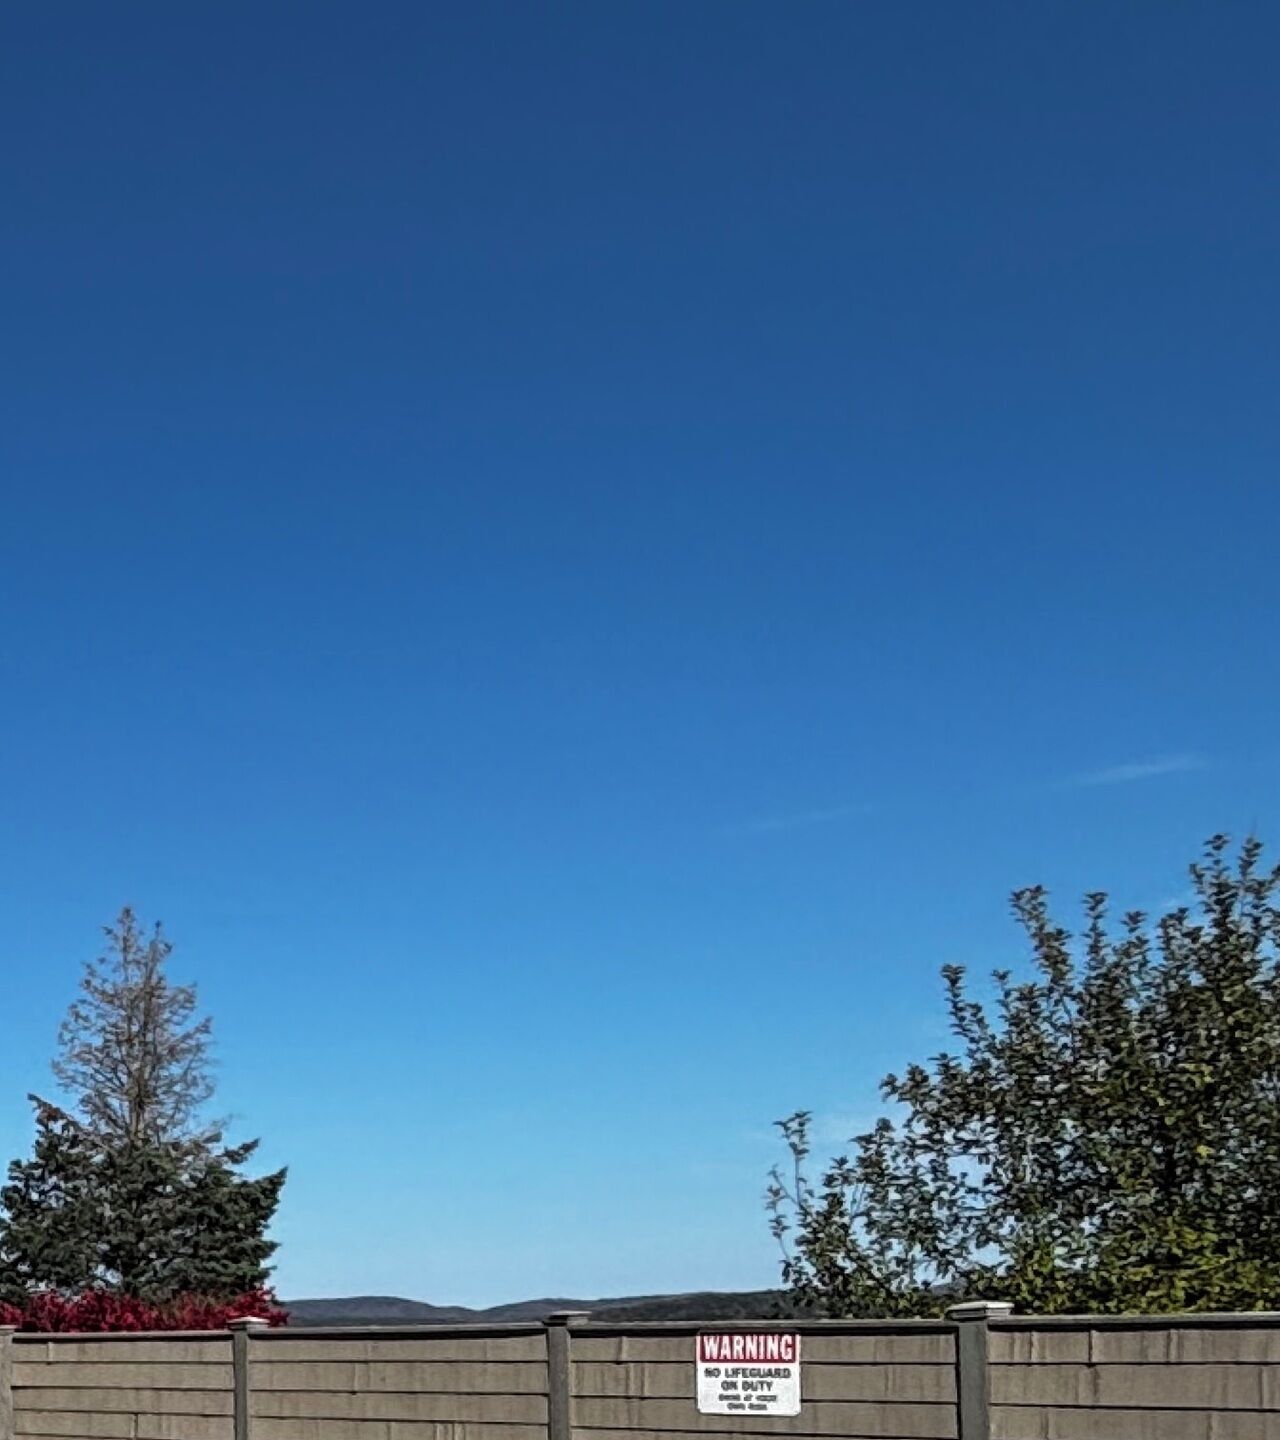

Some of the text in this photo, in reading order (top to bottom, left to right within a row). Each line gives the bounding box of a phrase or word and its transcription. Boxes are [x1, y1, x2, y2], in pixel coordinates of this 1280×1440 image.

[703, 1335, 793, 1360] WARNING
[704, 1367, 791, 1378] NO LIFEGUARD
[720, 1380, 773, 1391] ON DUTY
